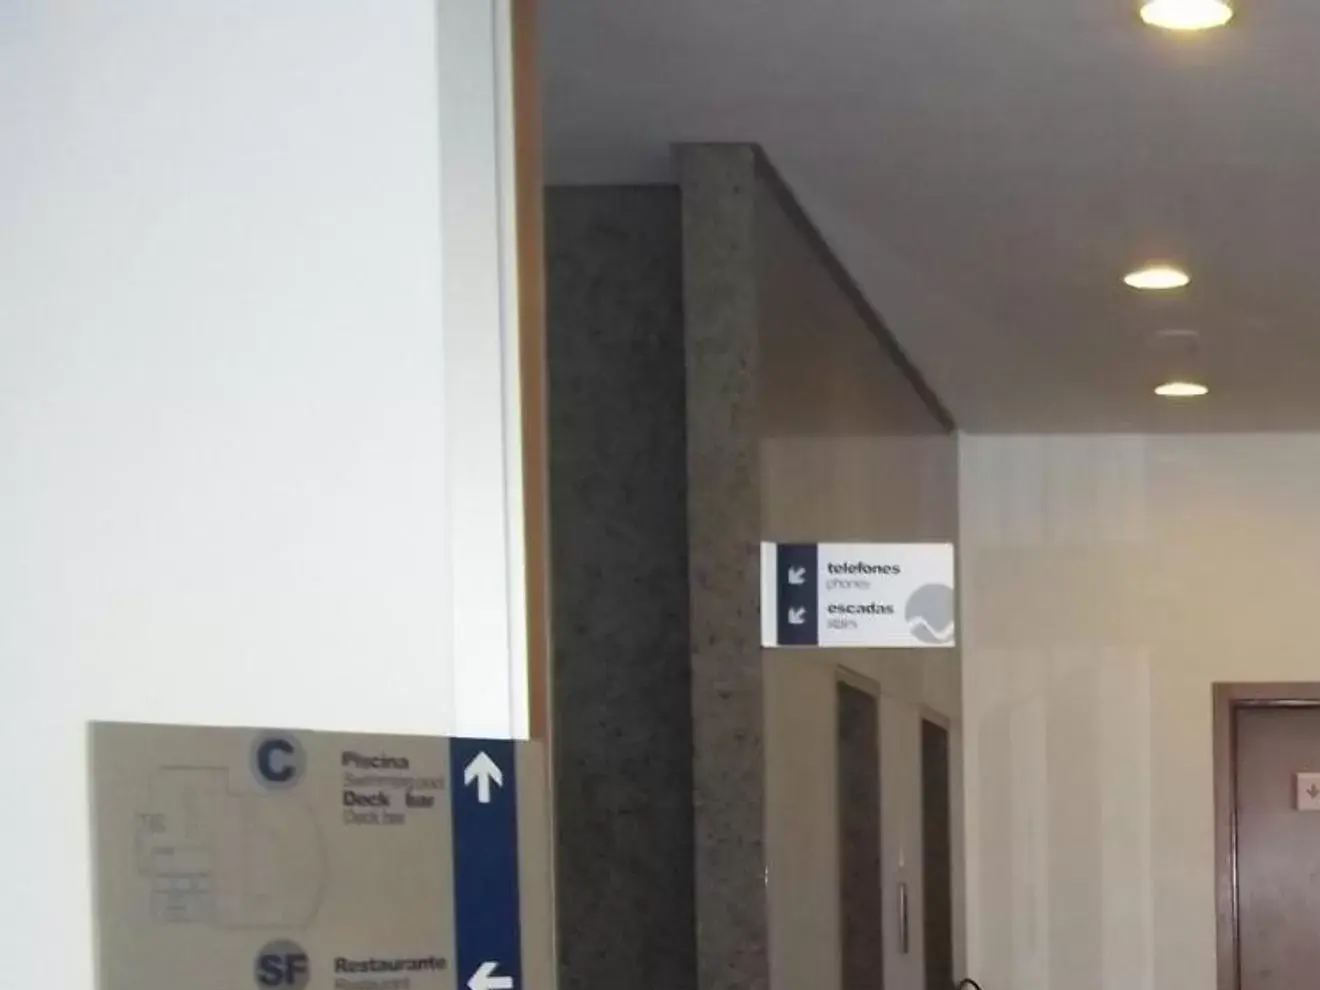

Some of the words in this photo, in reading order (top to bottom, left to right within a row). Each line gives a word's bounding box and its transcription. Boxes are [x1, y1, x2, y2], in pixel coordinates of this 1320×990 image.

[826, 561, 901, 575] telefones
[827, 601, 895, 615] escadas
[256, 739, 296, 783] C
[341, 751, 409, 769] Piscina
[343, 790, 390, 806] Deck
[257, 954, 308, 986] SF
[334, 956, 448, 973] Restaurante
